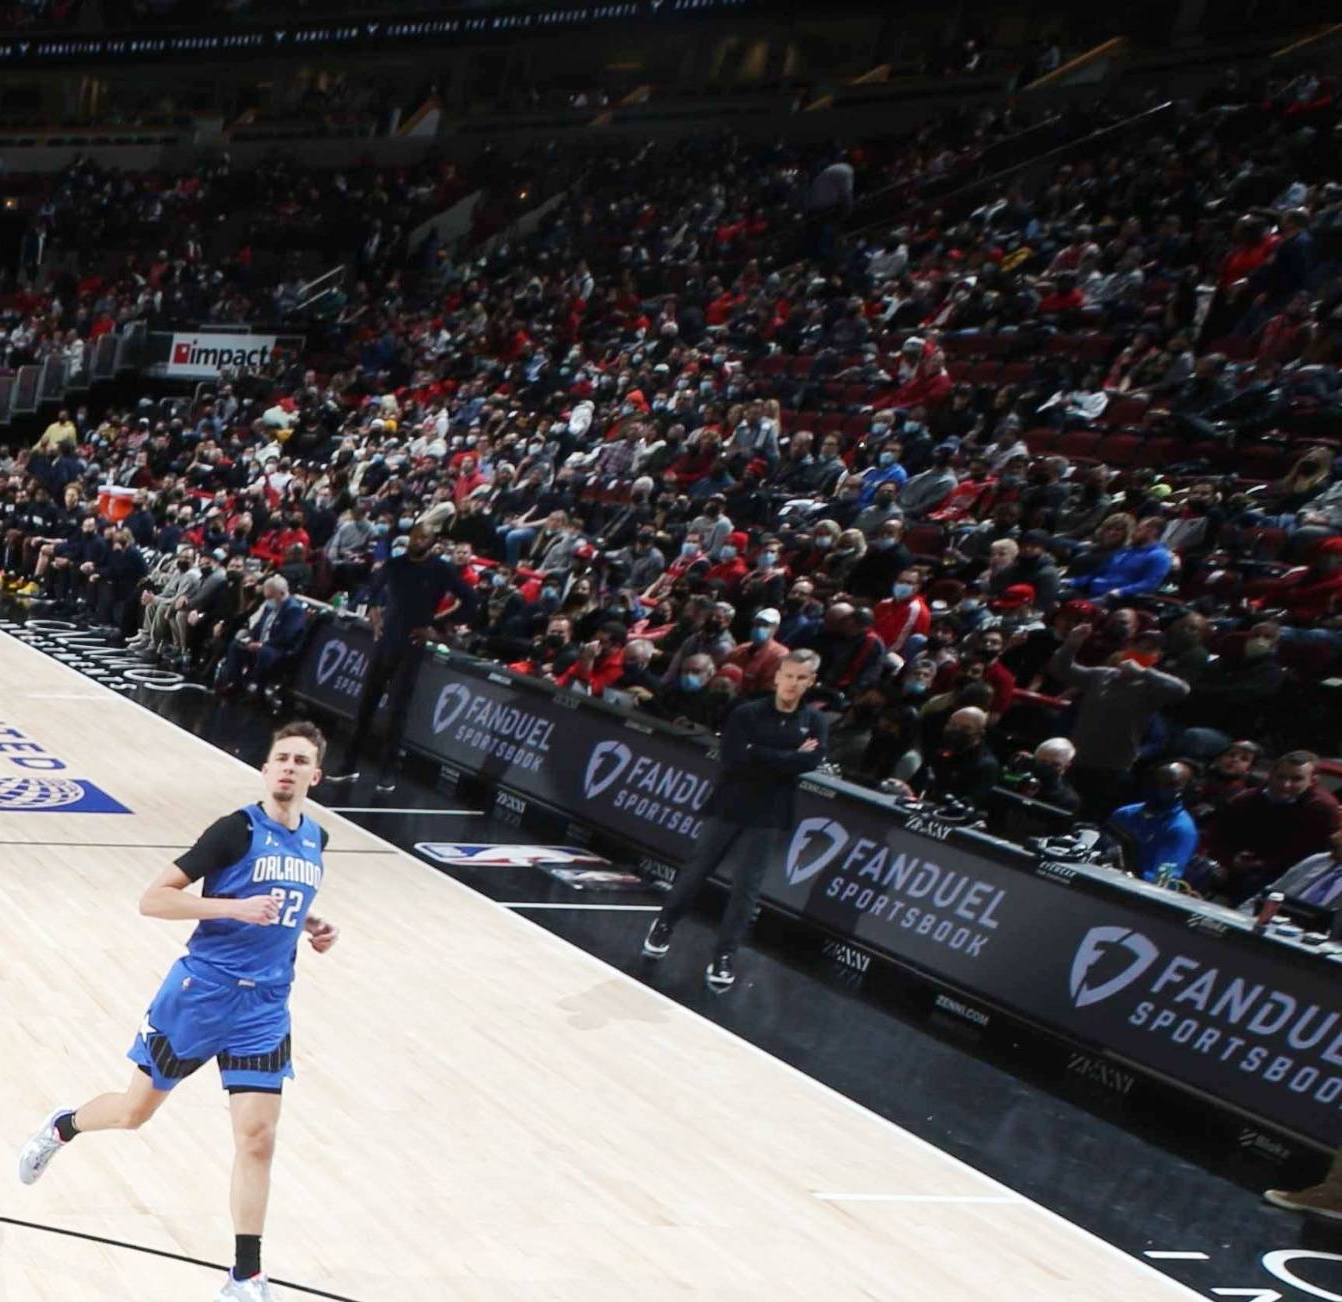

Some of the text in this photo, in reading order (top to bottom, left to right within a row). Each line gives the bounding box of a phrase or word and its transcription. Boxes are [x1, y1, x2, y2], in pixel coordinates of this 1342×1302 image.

[190, 339, 269, 370] impact
[455, 724, 547, 772] SPORTSBOOK
[465, 695, 555, 751] FANDUEL
[625, 756, 714, 811] FANDU
[843, 837, 1007, 929] FANDUEL
[824, 876, 990, 958] SPORTSBOOK
[1128, 1001, 1342, 1111] SPORTSBOO
